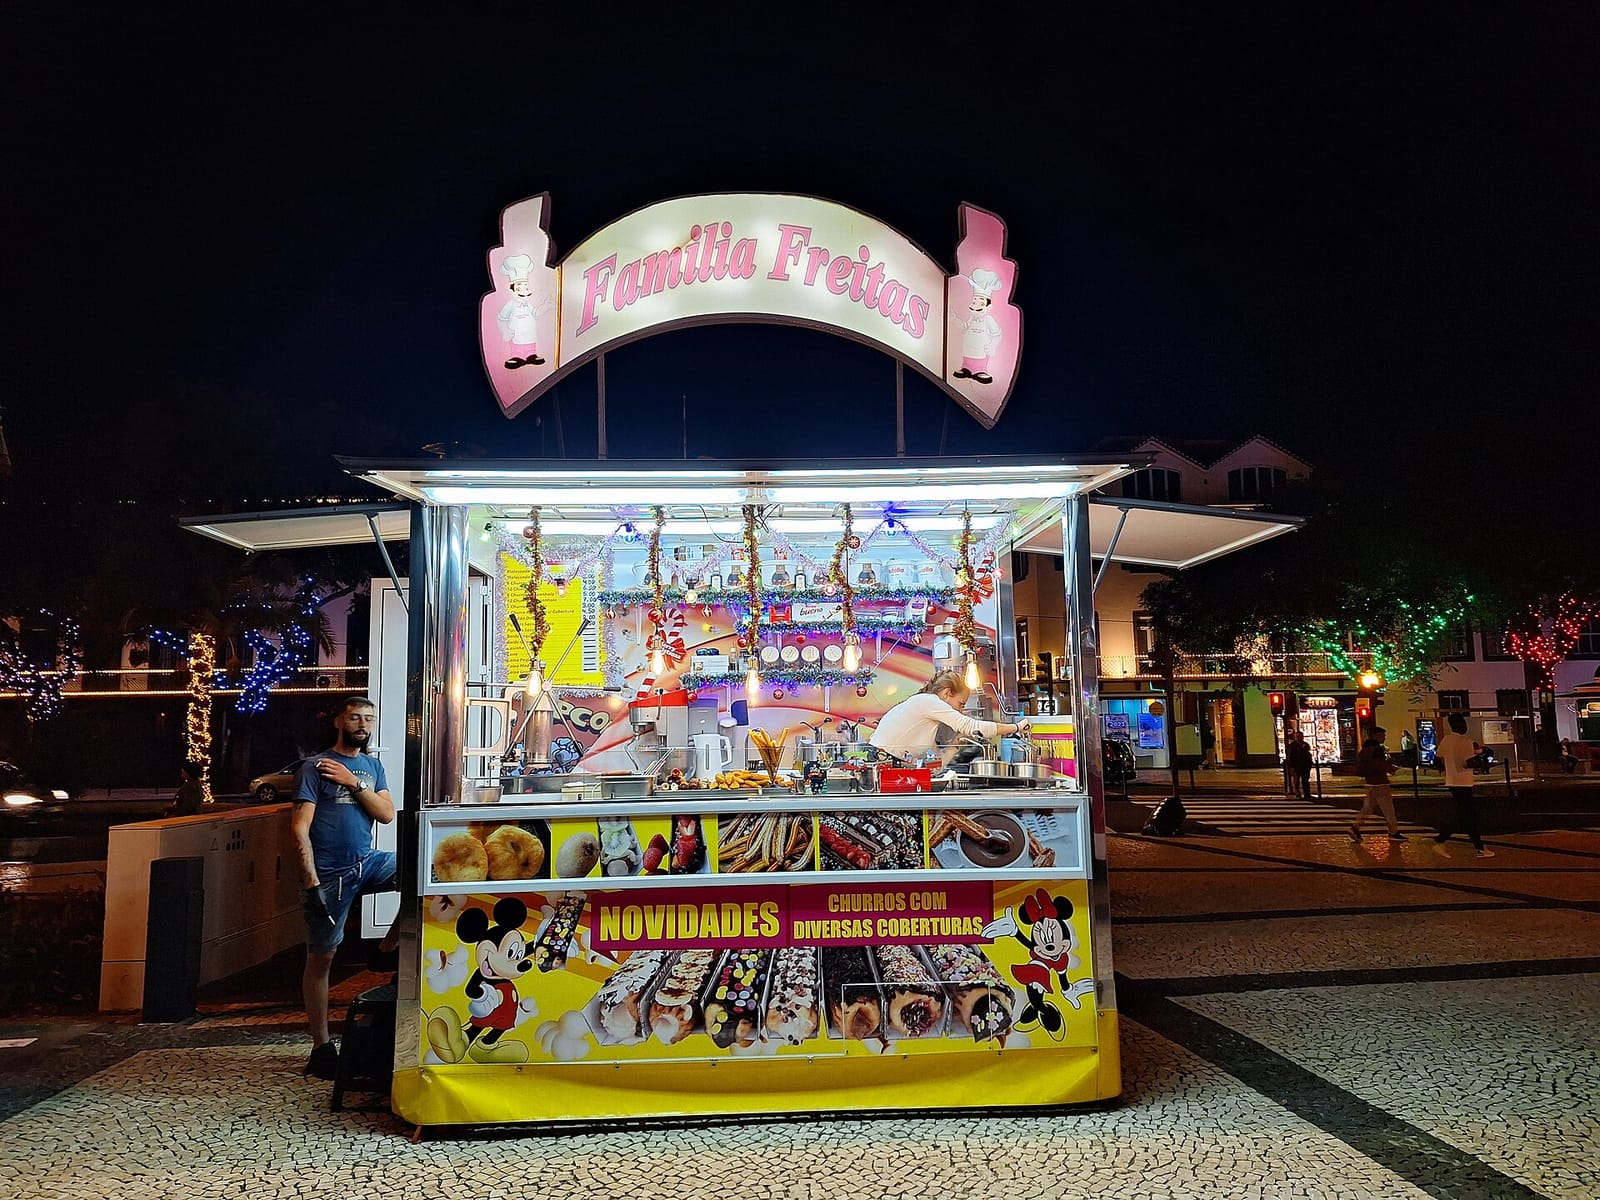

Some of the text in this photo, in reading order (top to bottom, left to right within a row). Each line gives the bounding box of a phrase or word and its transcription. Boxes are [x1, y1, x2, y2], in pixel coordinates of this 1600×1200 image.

[575, 220, 929, 339] Familia Freitas
[799, 607, 824, 616] bueno
[828, 891, 948, 913] CHURROS COM
[599, 901, 780, 942] NOVIDADES
[793, 916, 984, 940] DIVERSAS COBERTURAS
